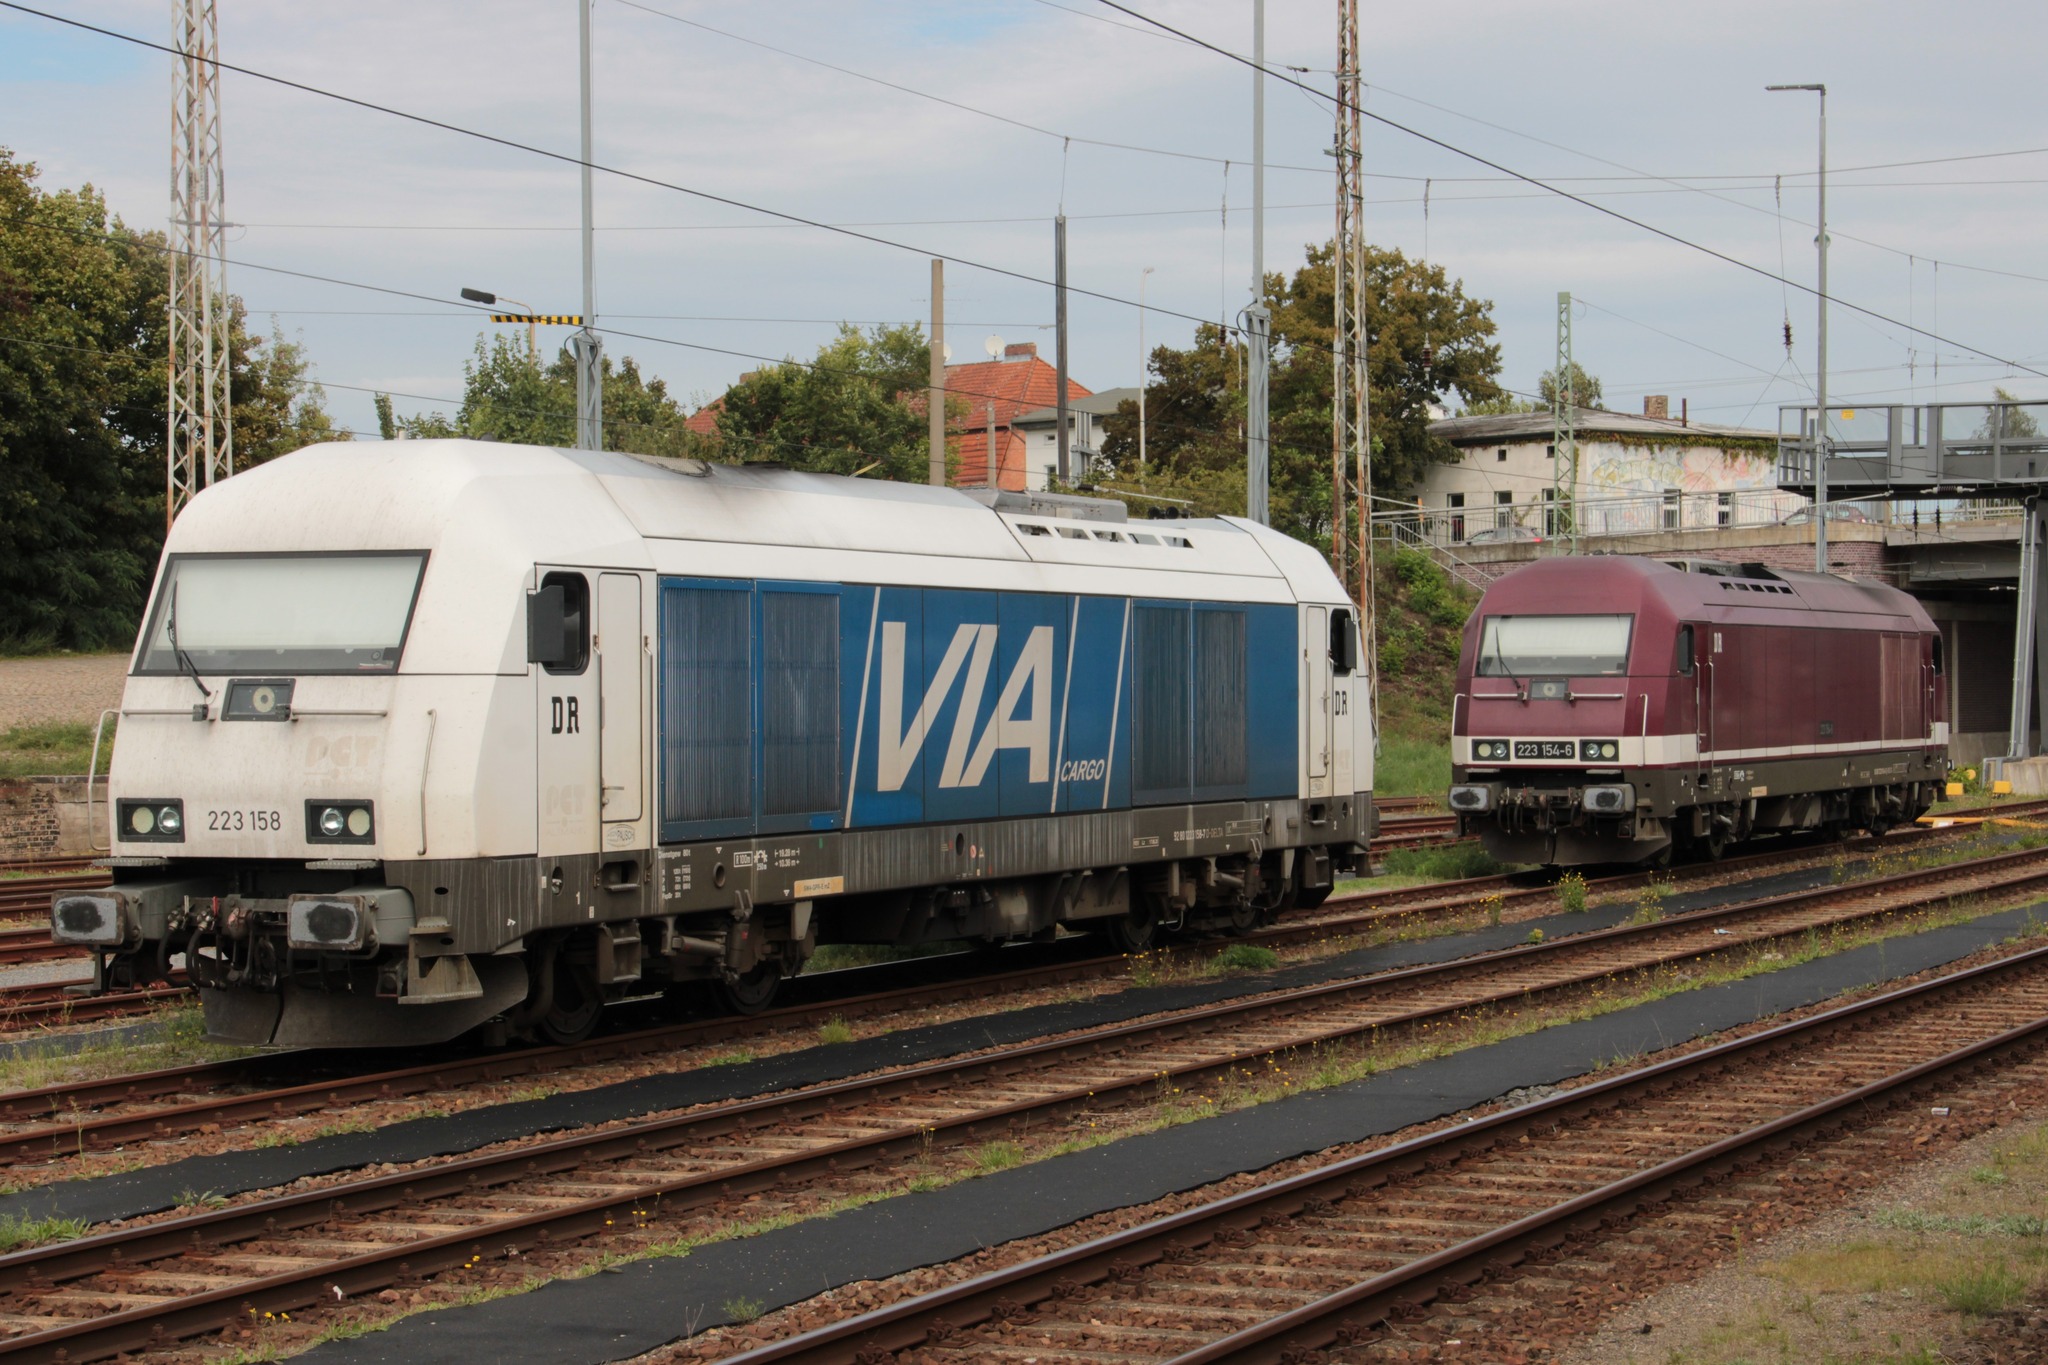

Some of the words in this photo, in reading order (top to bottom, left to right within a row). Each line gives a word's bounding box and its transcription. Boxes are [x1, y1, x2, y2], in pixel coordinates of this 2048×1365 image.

[877, 621, 1054, 792] VIA
[1335, 690, 1348, 716] DR
[551, 696, 580, 734] DR
[1517, 744, 1538, 757] 223
[1541, 744, 1572, 757] 154-6
[1060, 759, 1105, 782] CARGO
[208, 810, 244, 831] 223
[249, 810, 281, 831] 158
[576, 891, 580, 905] 1
